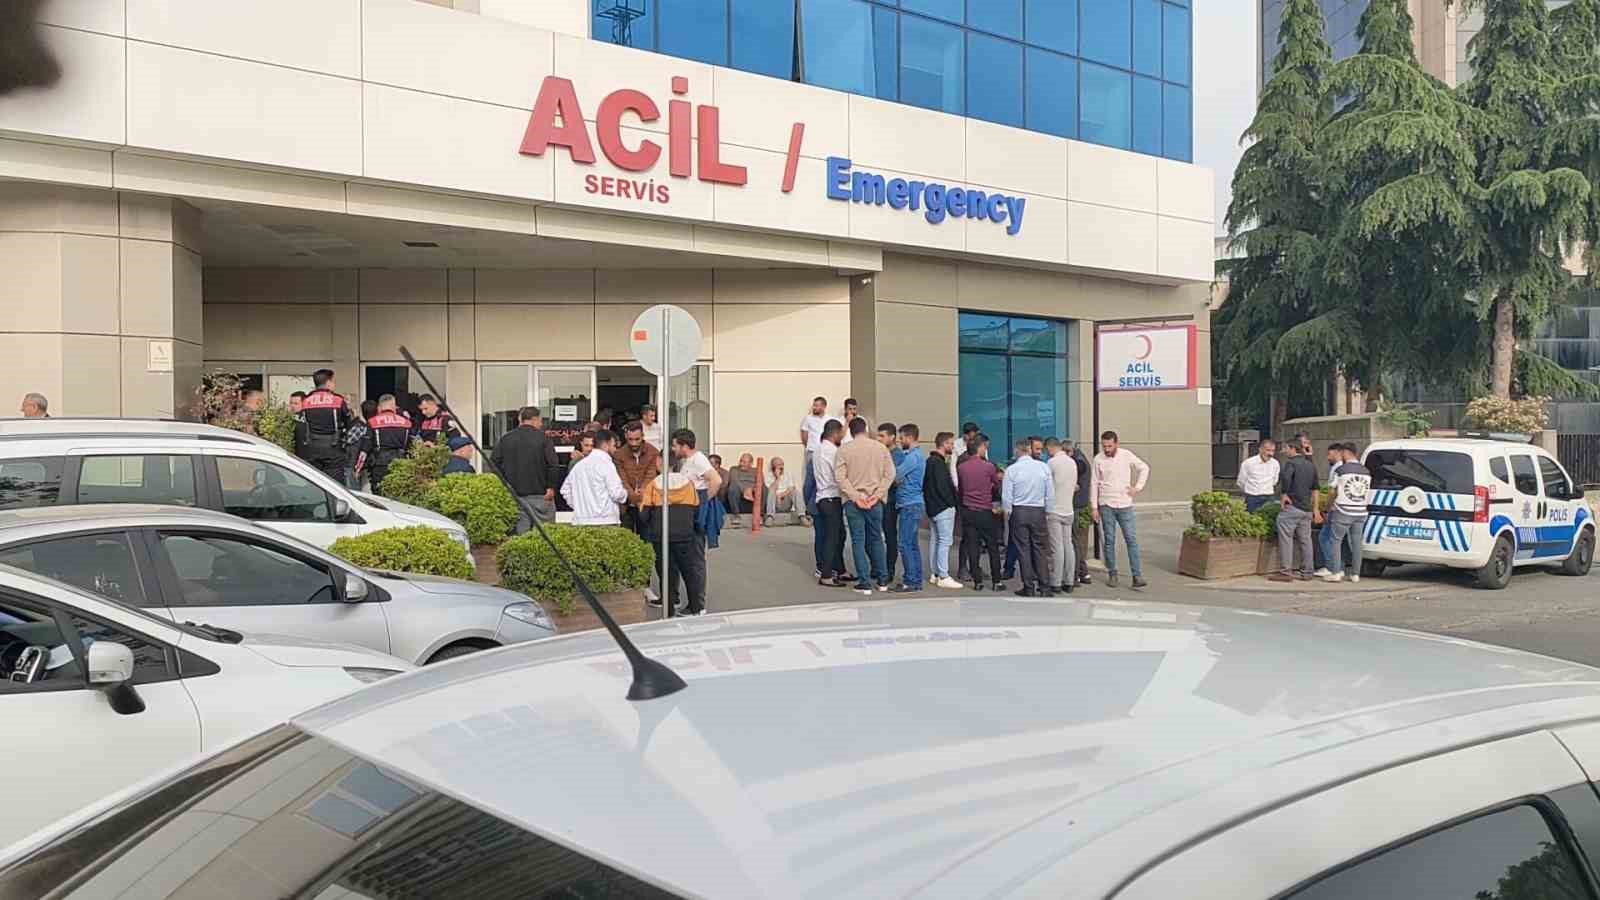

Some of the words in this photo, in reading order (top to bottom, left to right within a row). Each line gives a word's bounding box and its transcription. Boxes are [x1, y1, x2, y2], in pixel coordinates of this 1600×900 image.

[518, 75, 748, 186] ACİL
[826, 155, 1026, 236] Emergency
[584, 174, 670, 204] SERVİS
